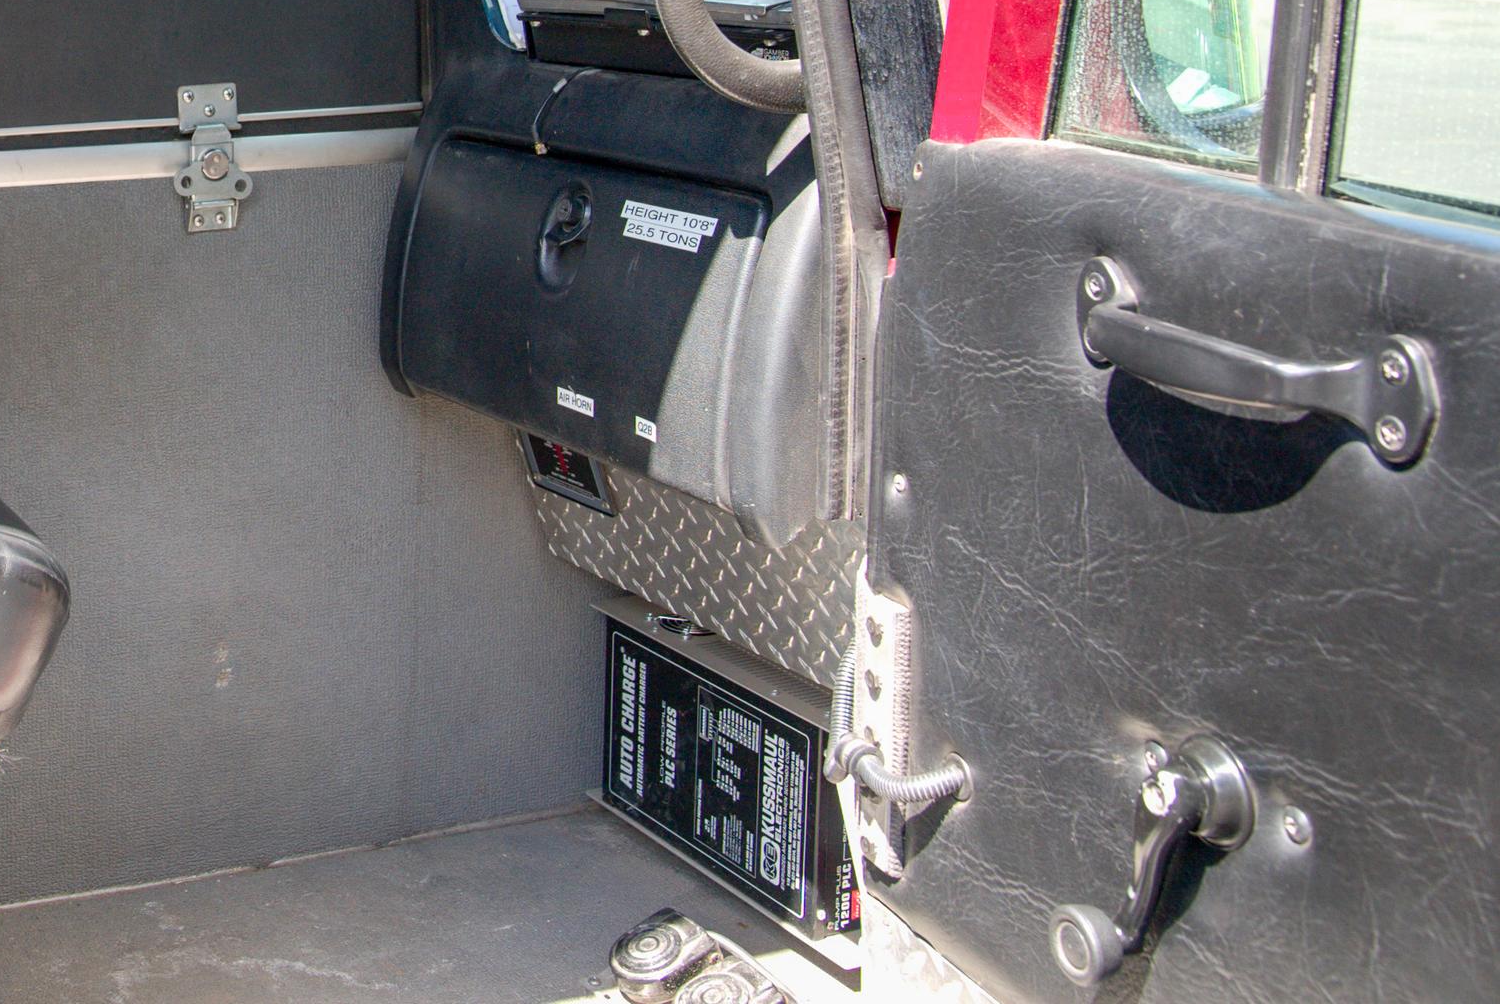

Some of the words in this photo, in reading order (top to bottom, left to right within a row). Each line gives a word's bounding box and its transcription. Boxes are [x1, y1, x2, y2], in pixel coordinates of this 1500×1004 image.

[624, 204, 679, 224] HEIGHT
[627, 223, 655, 238] 25.5
[659, 229, 699, 248] TONS
[558, 391, 571, 404] AIR
[571, 395, 592, 412] HORN
[637, 421, 653, 436] Q2B
[638, 660, 646, 705] CHARGER
[637, 703, 645, 744] BATTERY
[665, 704, 676, 758] SERIES
[620, 733, 633, 789] AUTO
[636, 742, 644, 797] AUTOMATIC
[664, 757, 675, 788] PLC
[761, 728, 778, 839] KUSSMAUL
[774, 736, 785, 843] ELECTRONICS
[842, 863, 852, 889] PLC
[840, 892, 851, 929] 1200
